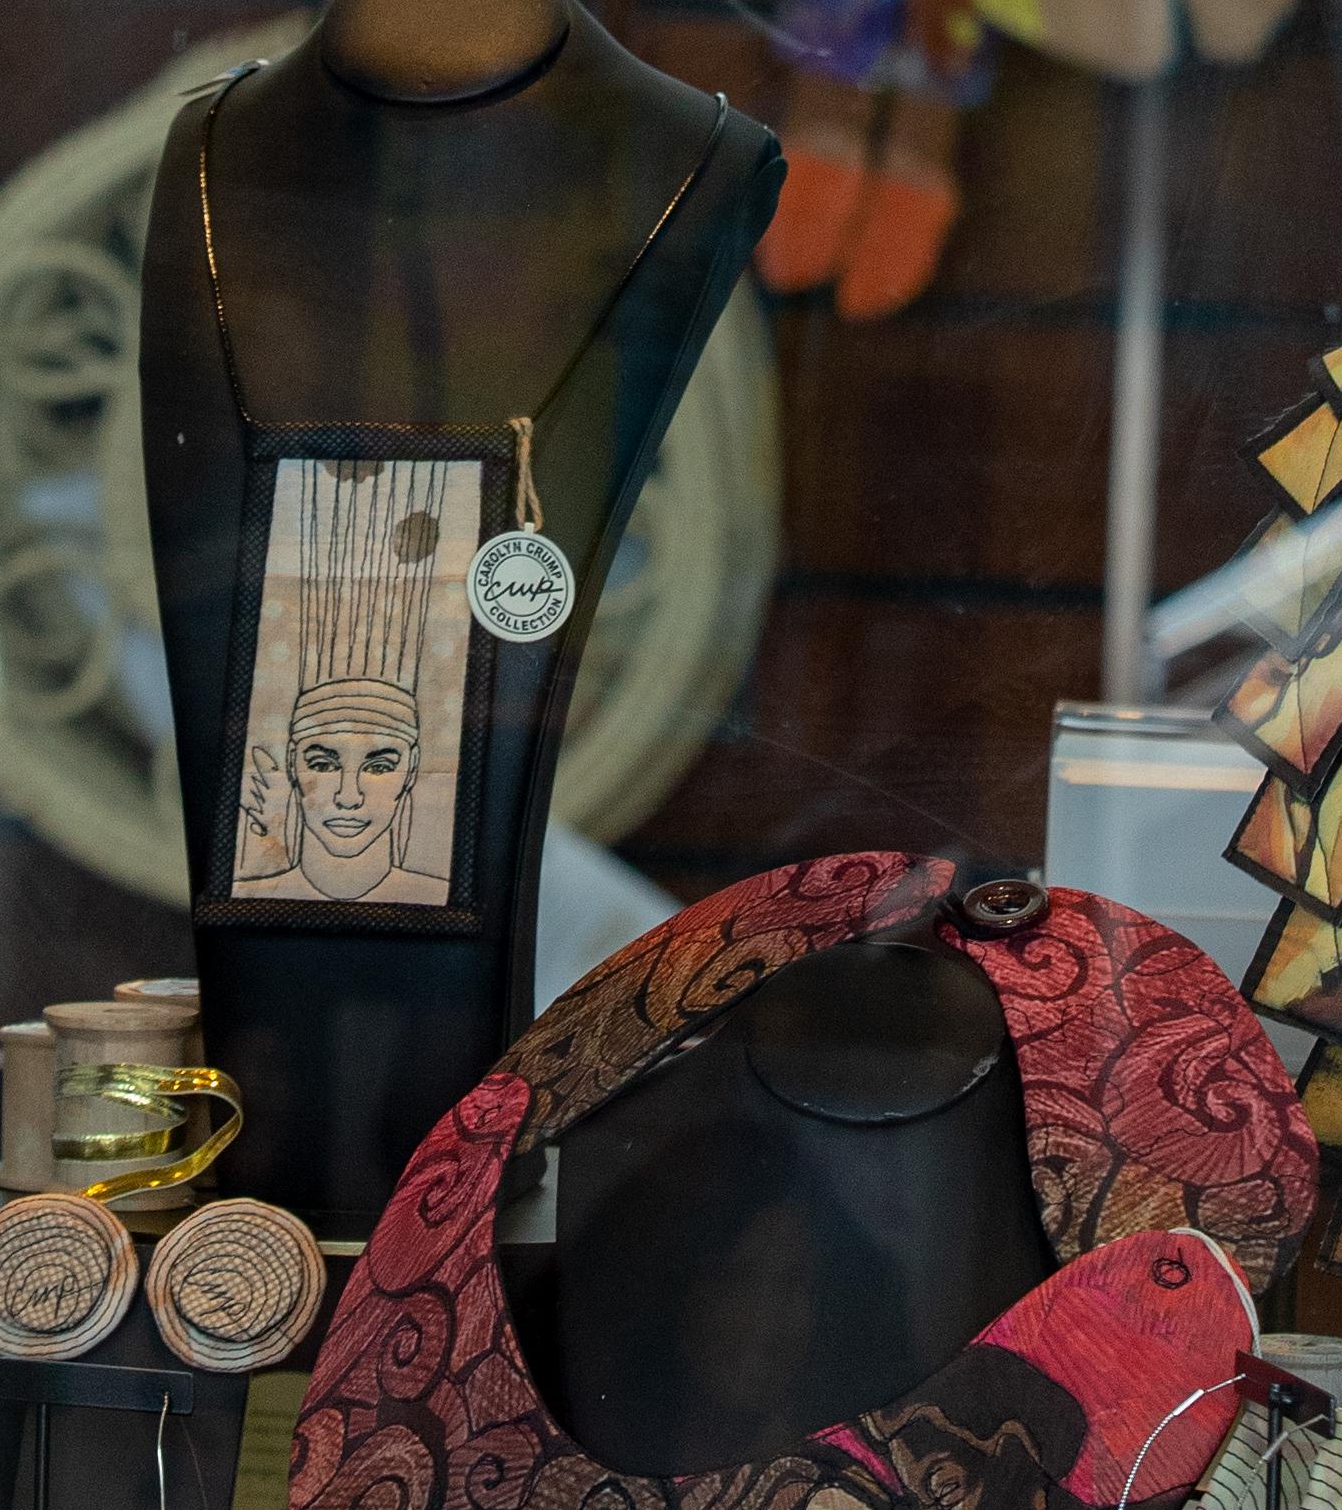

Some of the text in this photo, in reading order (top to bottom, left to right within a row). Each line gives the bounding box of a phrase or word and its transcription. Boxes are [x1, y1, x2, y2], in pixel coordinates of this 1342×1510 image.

[478, 541, 562, 587] CAROLYN CRUMP
[489, 598, 562, 632] COLLECTION
